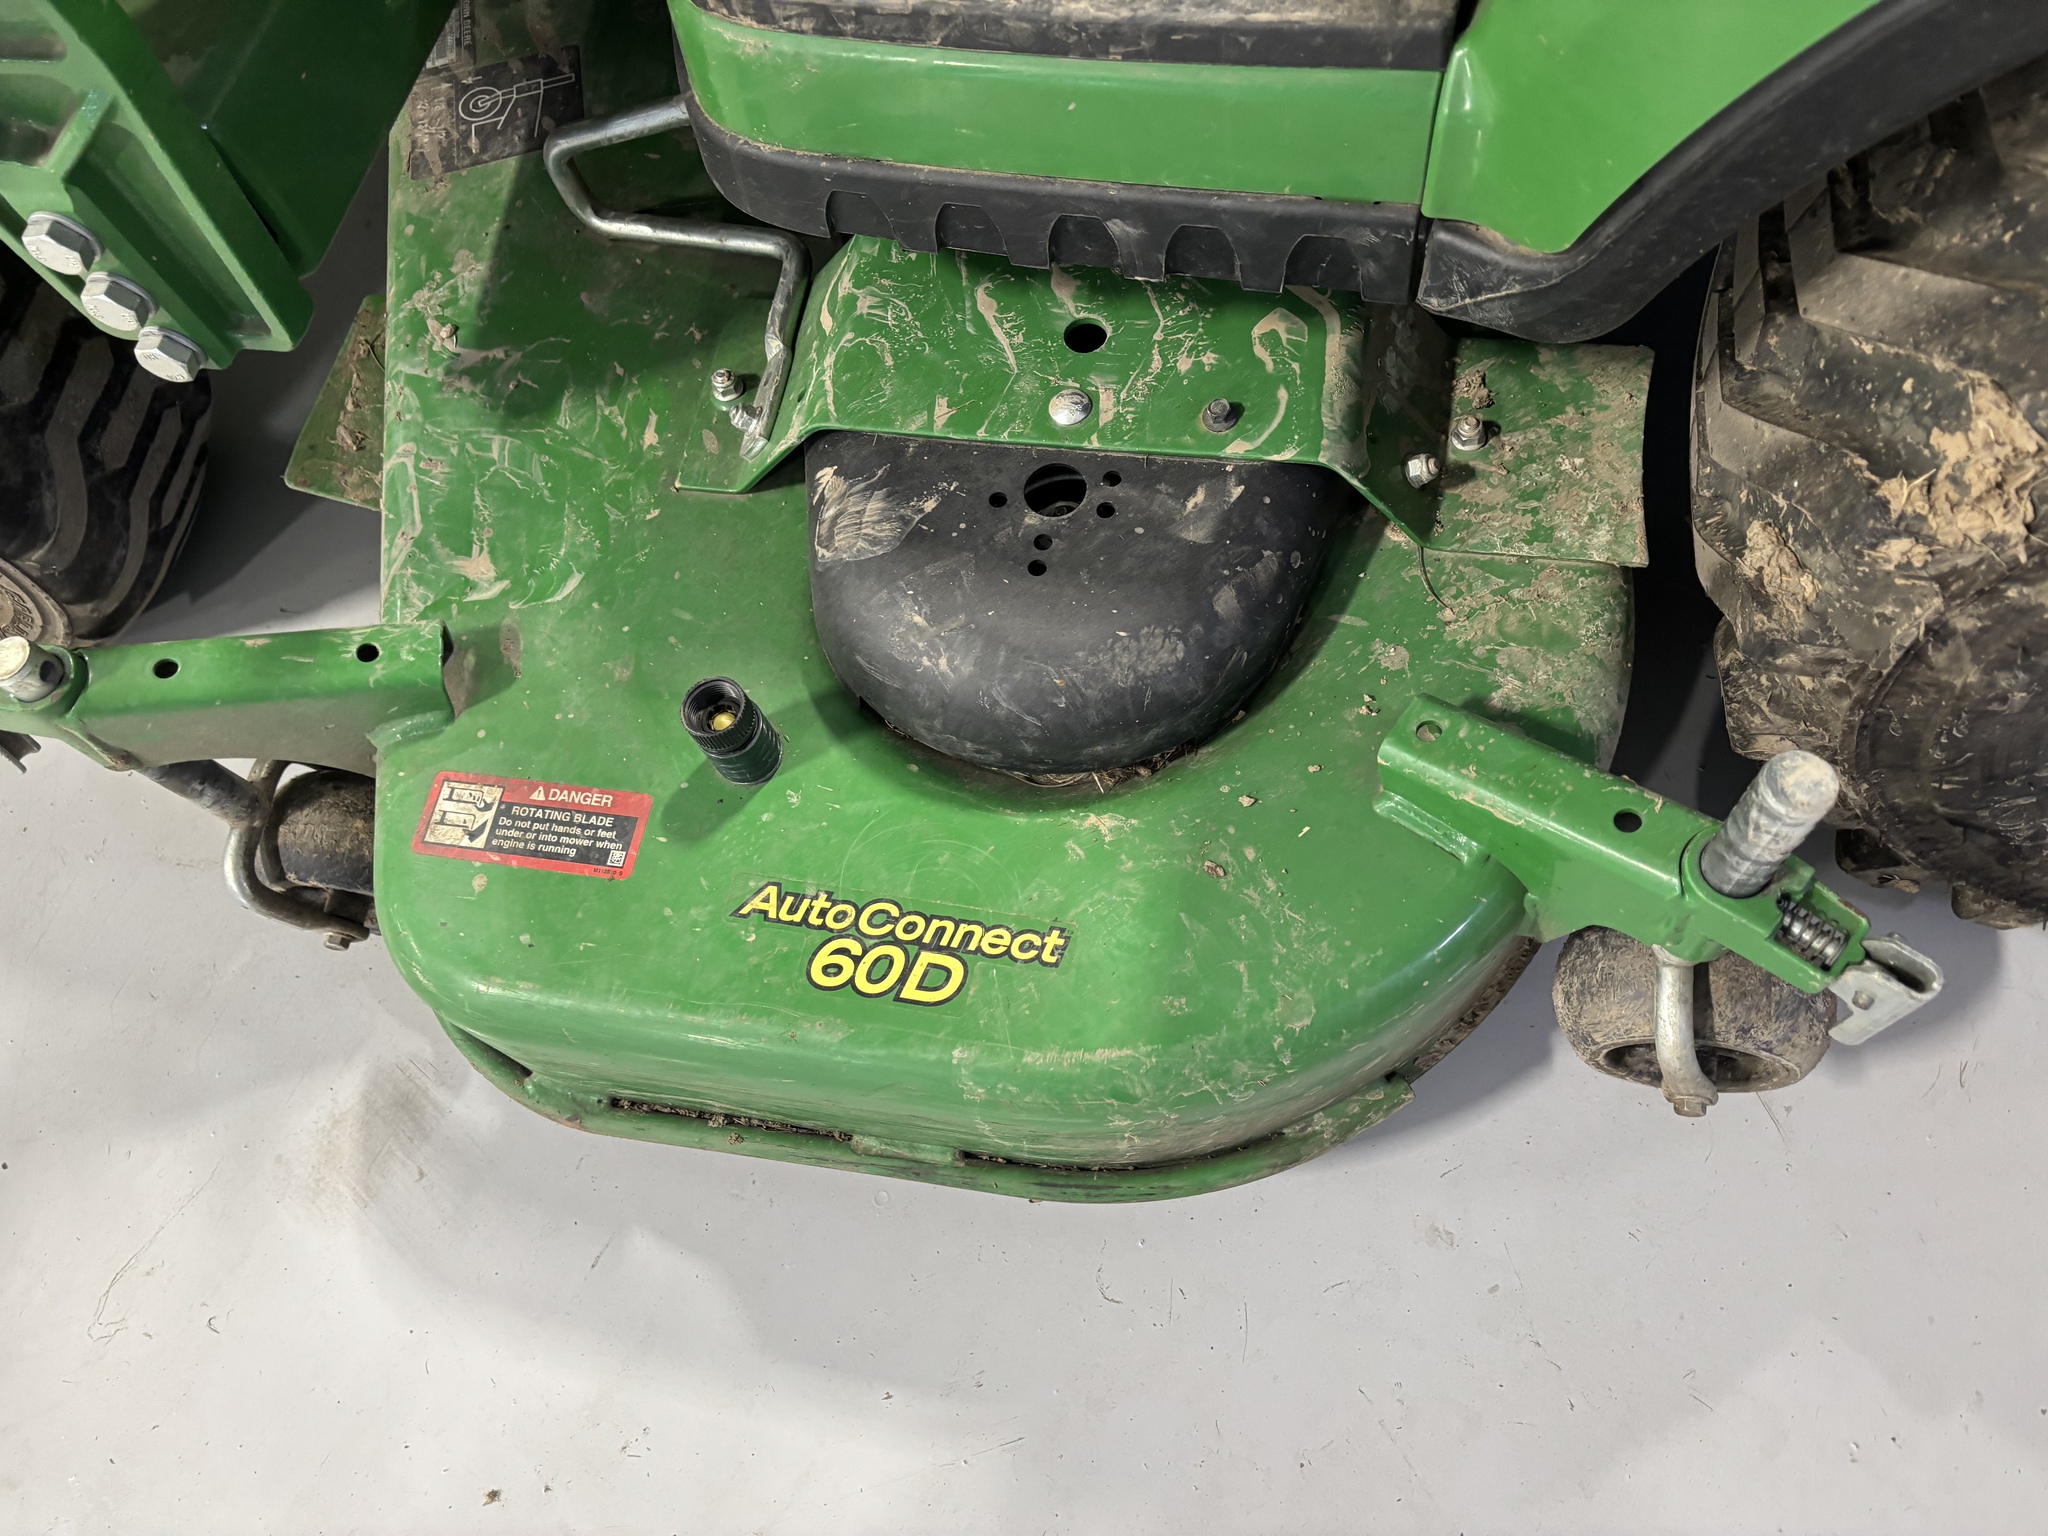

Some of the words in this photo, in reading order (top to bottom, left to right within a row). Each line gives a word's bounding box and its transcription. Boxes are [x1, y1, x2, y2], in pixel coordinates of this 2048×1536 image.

[463, 19, 472, 46] DEERE
[548, 788, 613, 807] DANGER
[498, 816, 512, 826] Do
[514, 819, 531, 829] not
[532, 821, 549, 831] put
[551, 823, 582, 835] hands
[584, 829, 595, 837] or
[597, 828, 617, 839] feet
[511, 805, 572, 822] ROTATING
[573, 813, 614, 827] BLADE
[491, 837, 525, 850] engine
[527, 841, 536, 851] is
[538, 843, 577, 857] running
[495, 828, 523, 839] under
[525, 832, 536, 840] or
[538, 832, 558, 843] into
[560, 836, 594, 848] mower
[596, 840, 623, 851] when
[733, 883, 1068, 966] AutoConnect
[808, 936, 966, 1005] 60D
